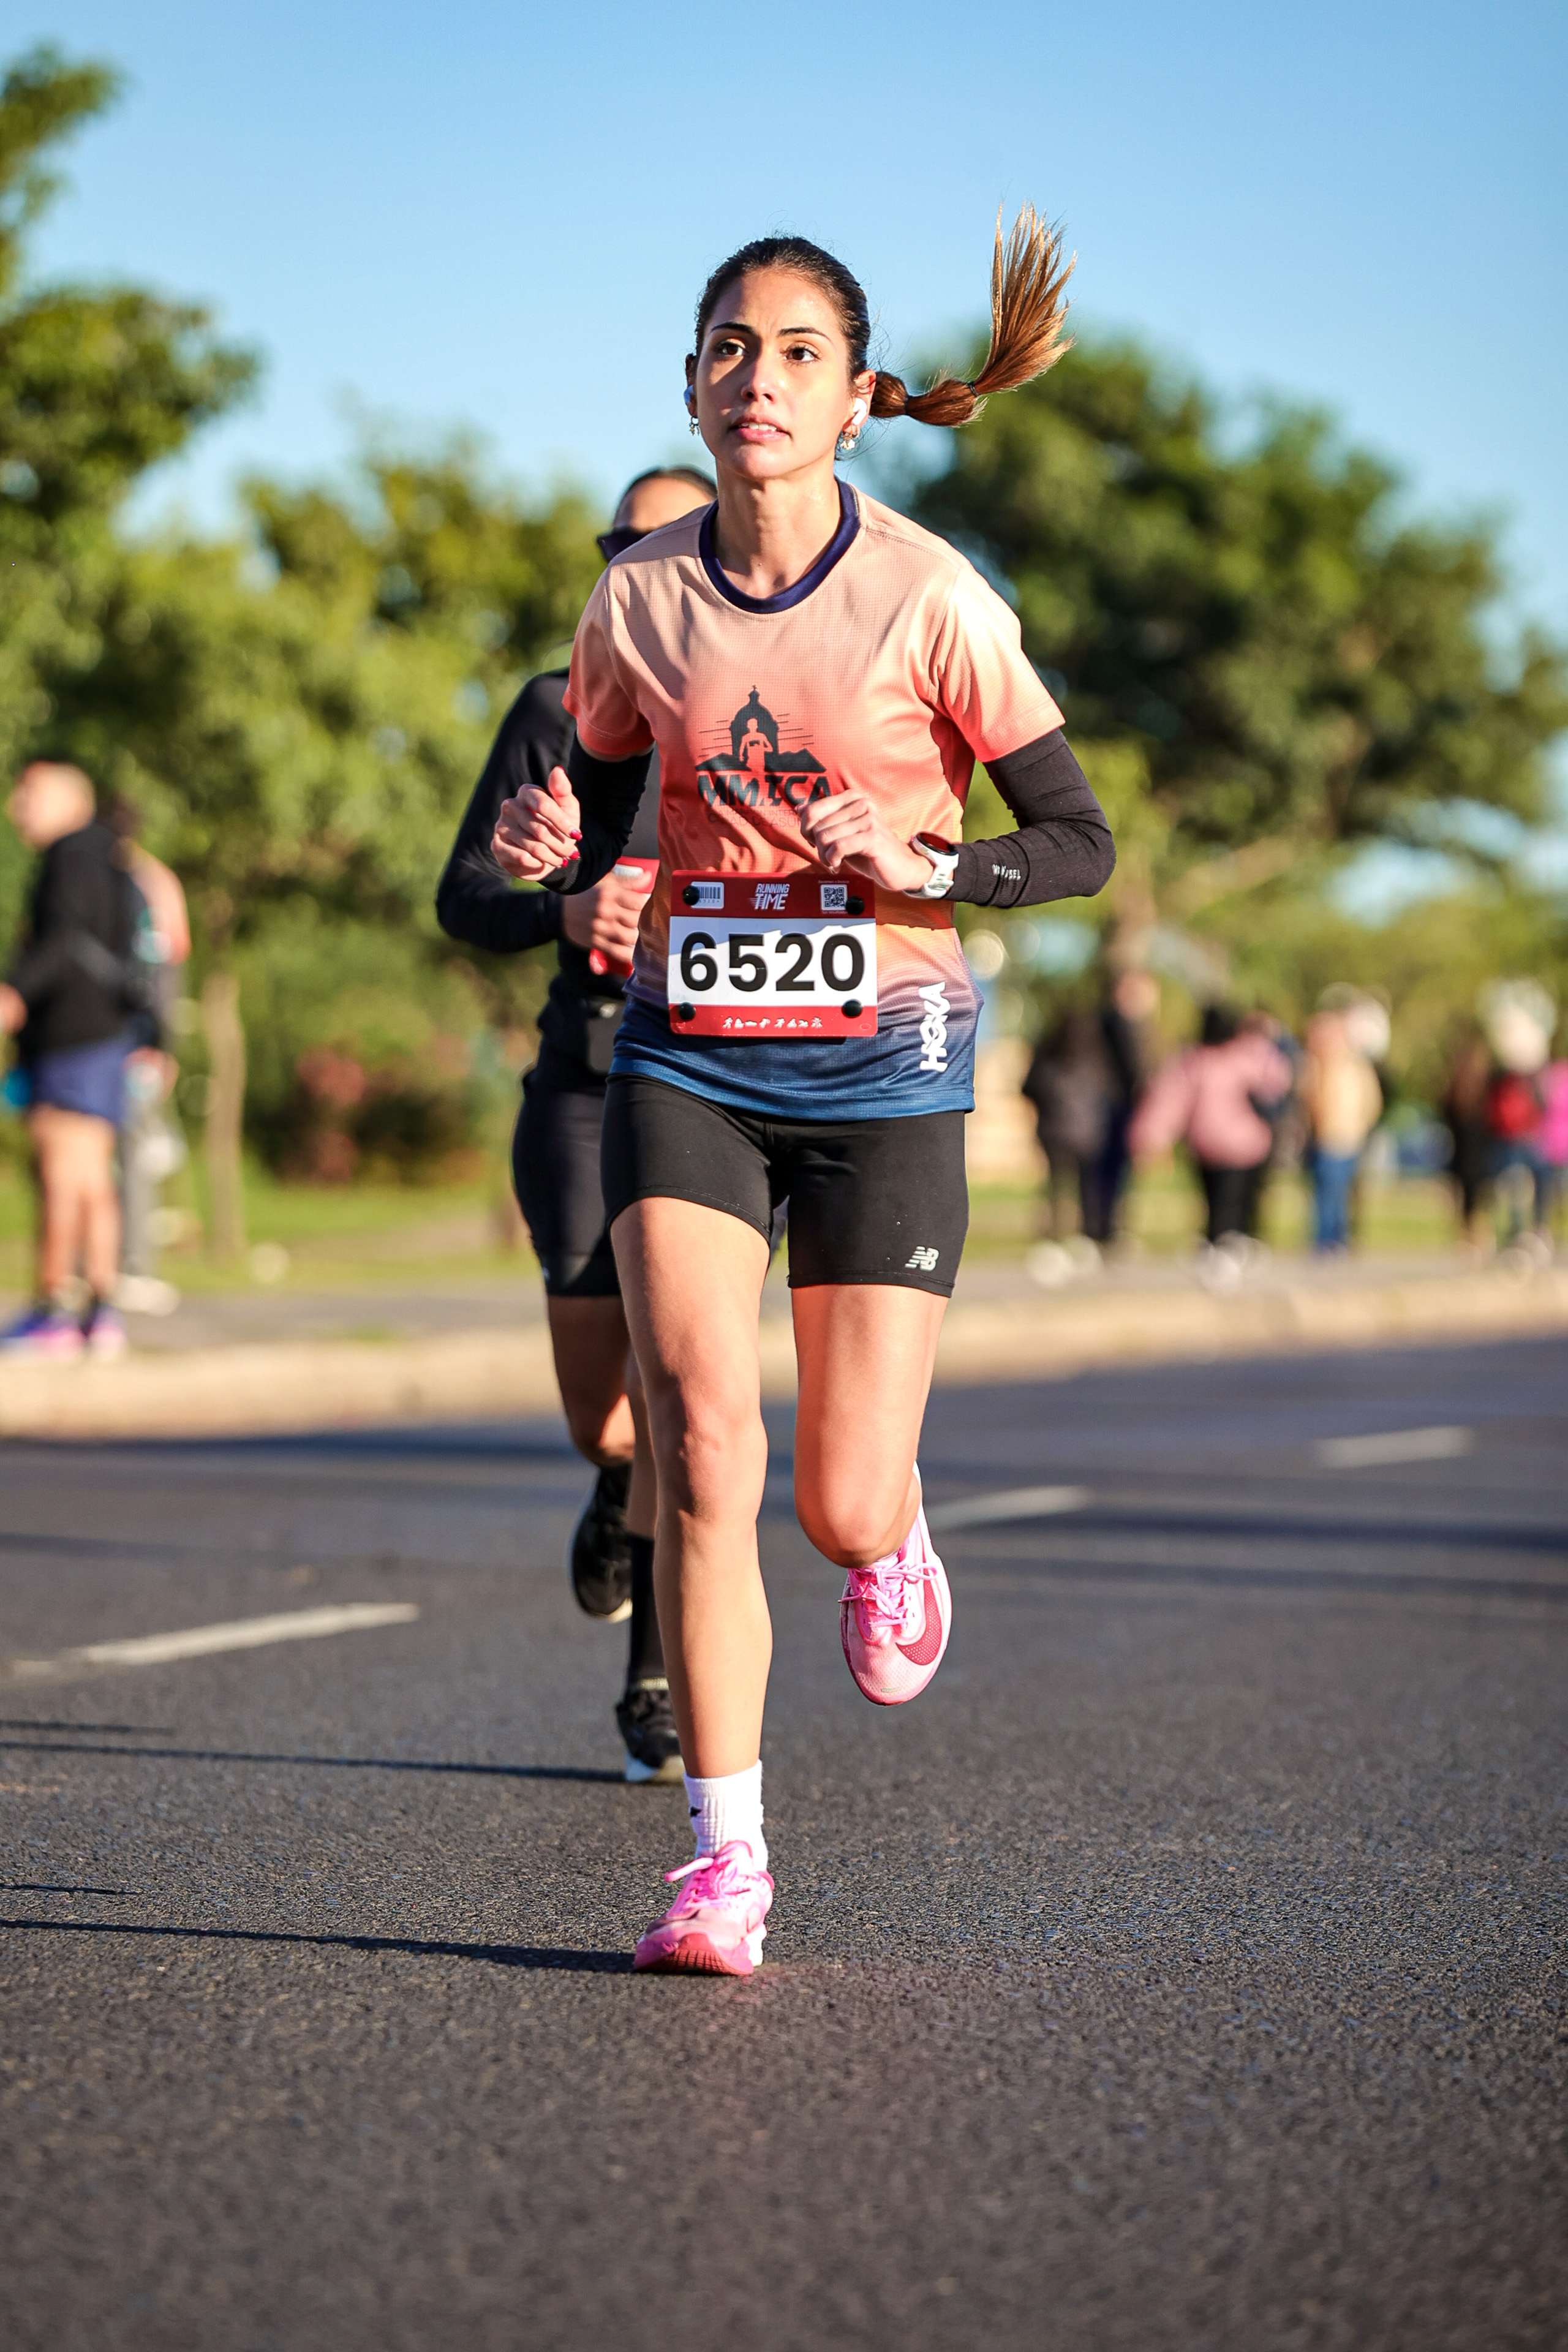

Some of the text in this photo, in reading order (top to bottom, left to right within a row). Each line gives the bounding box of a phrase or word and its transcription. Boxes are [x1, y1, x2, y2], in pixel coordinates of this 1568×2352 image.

[754, 894, 788, 910] TIME
[756, 883, 790, 894] RUNNING
[680, 932, 865, 992] 6520
[919, 981, 951, 1073] HOKA
